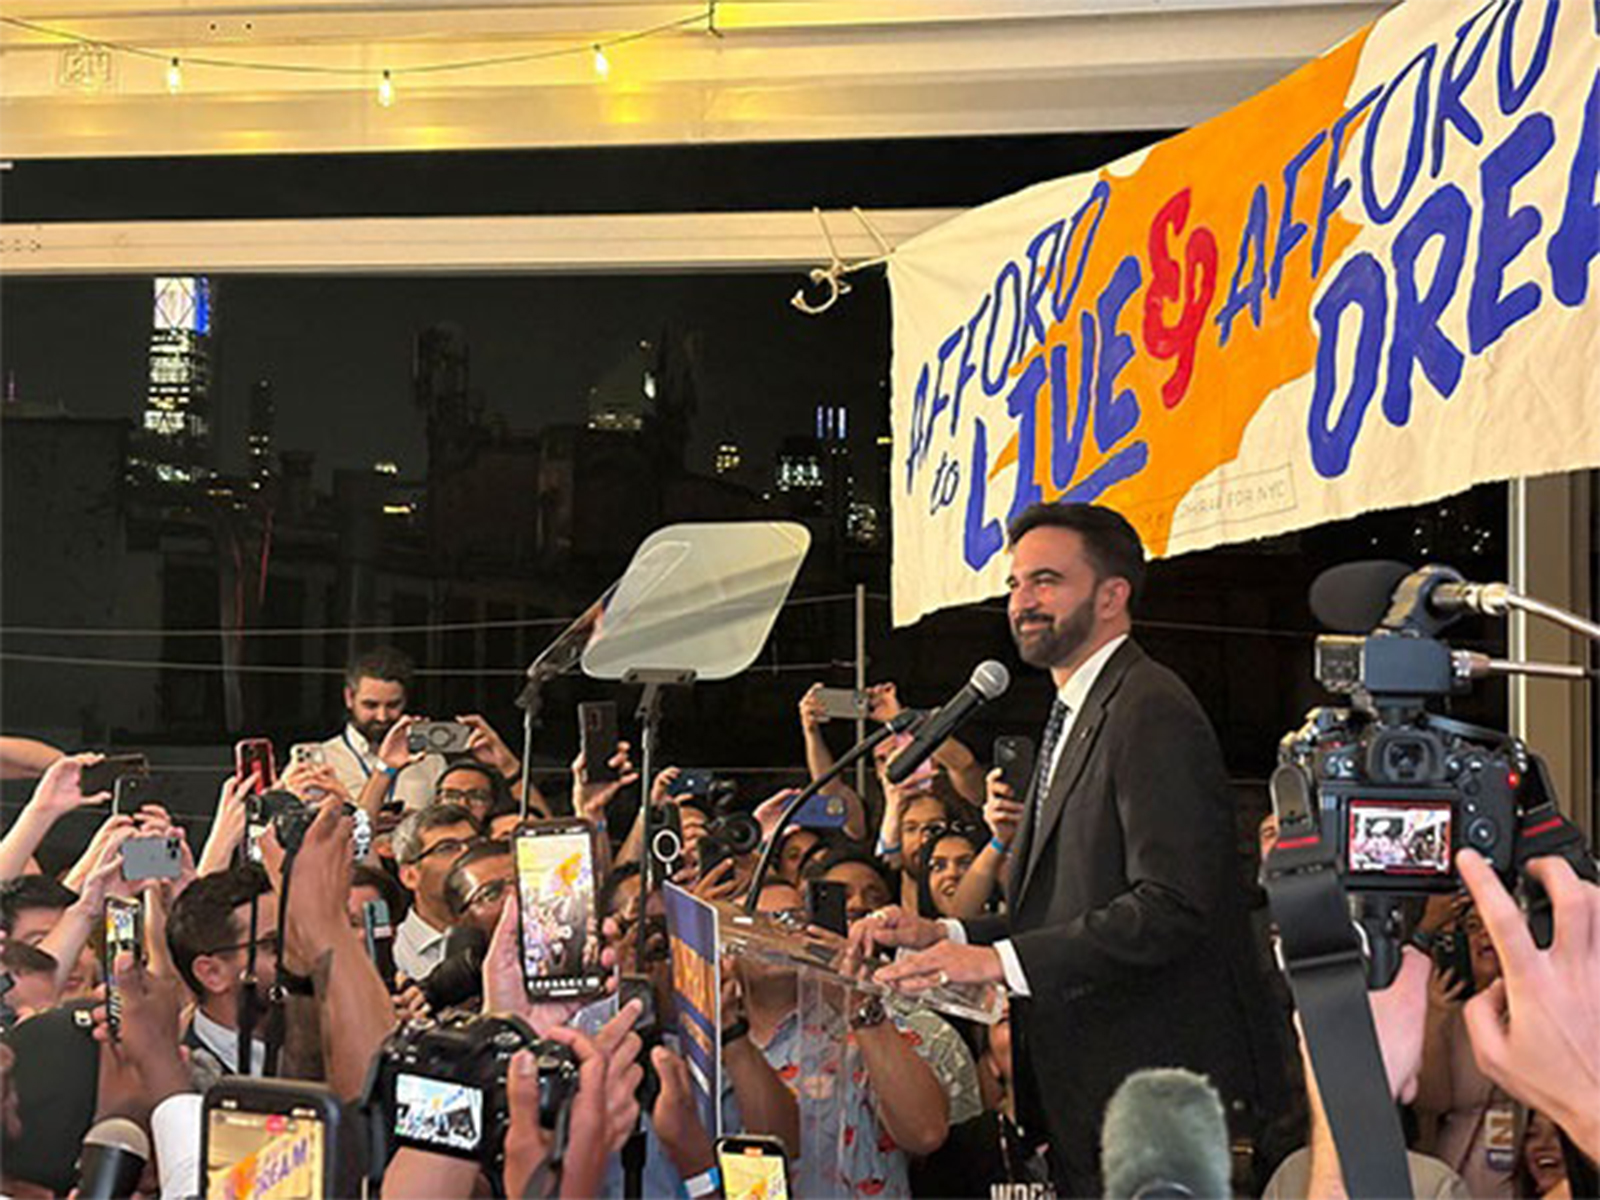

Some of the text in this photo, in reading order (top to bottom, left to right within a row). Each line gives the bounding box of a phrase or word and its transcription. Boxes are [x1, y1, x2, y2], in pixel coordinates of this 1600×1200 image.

[1214, 0, 1560, 347] AFFORD
[906, 180, 1111, 495] AFFORD
[930, 255, 1143, 572] to LIVE
